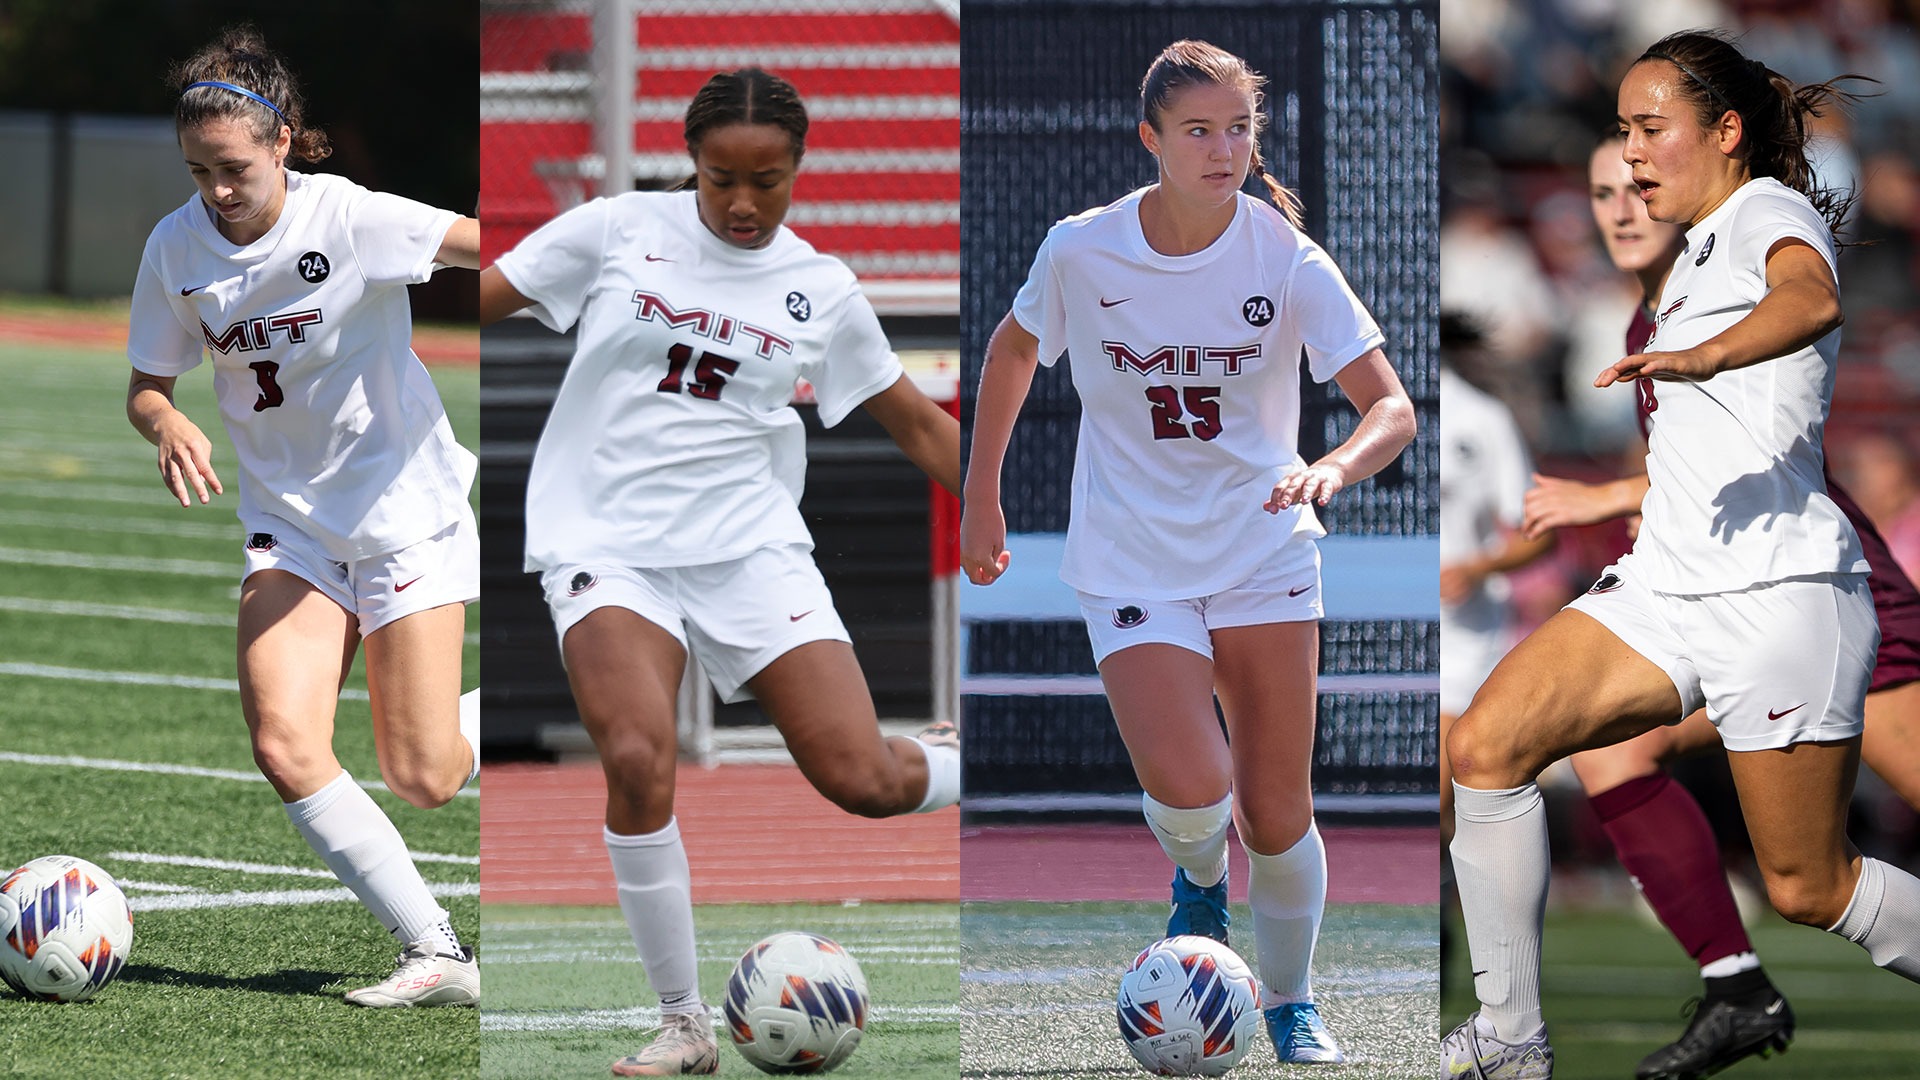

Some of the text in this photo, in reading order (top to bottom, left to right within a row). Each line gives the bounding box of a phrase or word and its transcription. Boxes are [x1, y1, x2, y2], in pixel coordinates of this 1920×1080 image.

[301, 255, 326, 278] 24
[631, 289, 794, 360] MIT
[789, 293, 809, 319] 24
[1246, 300, 1271, 321] 24
[199, 308, 323, 355] MIT
[656, 342, 741, 401] 15
[1101, 340, 1262, 377] MIT
[1144, 384, 1224, 441] 25
